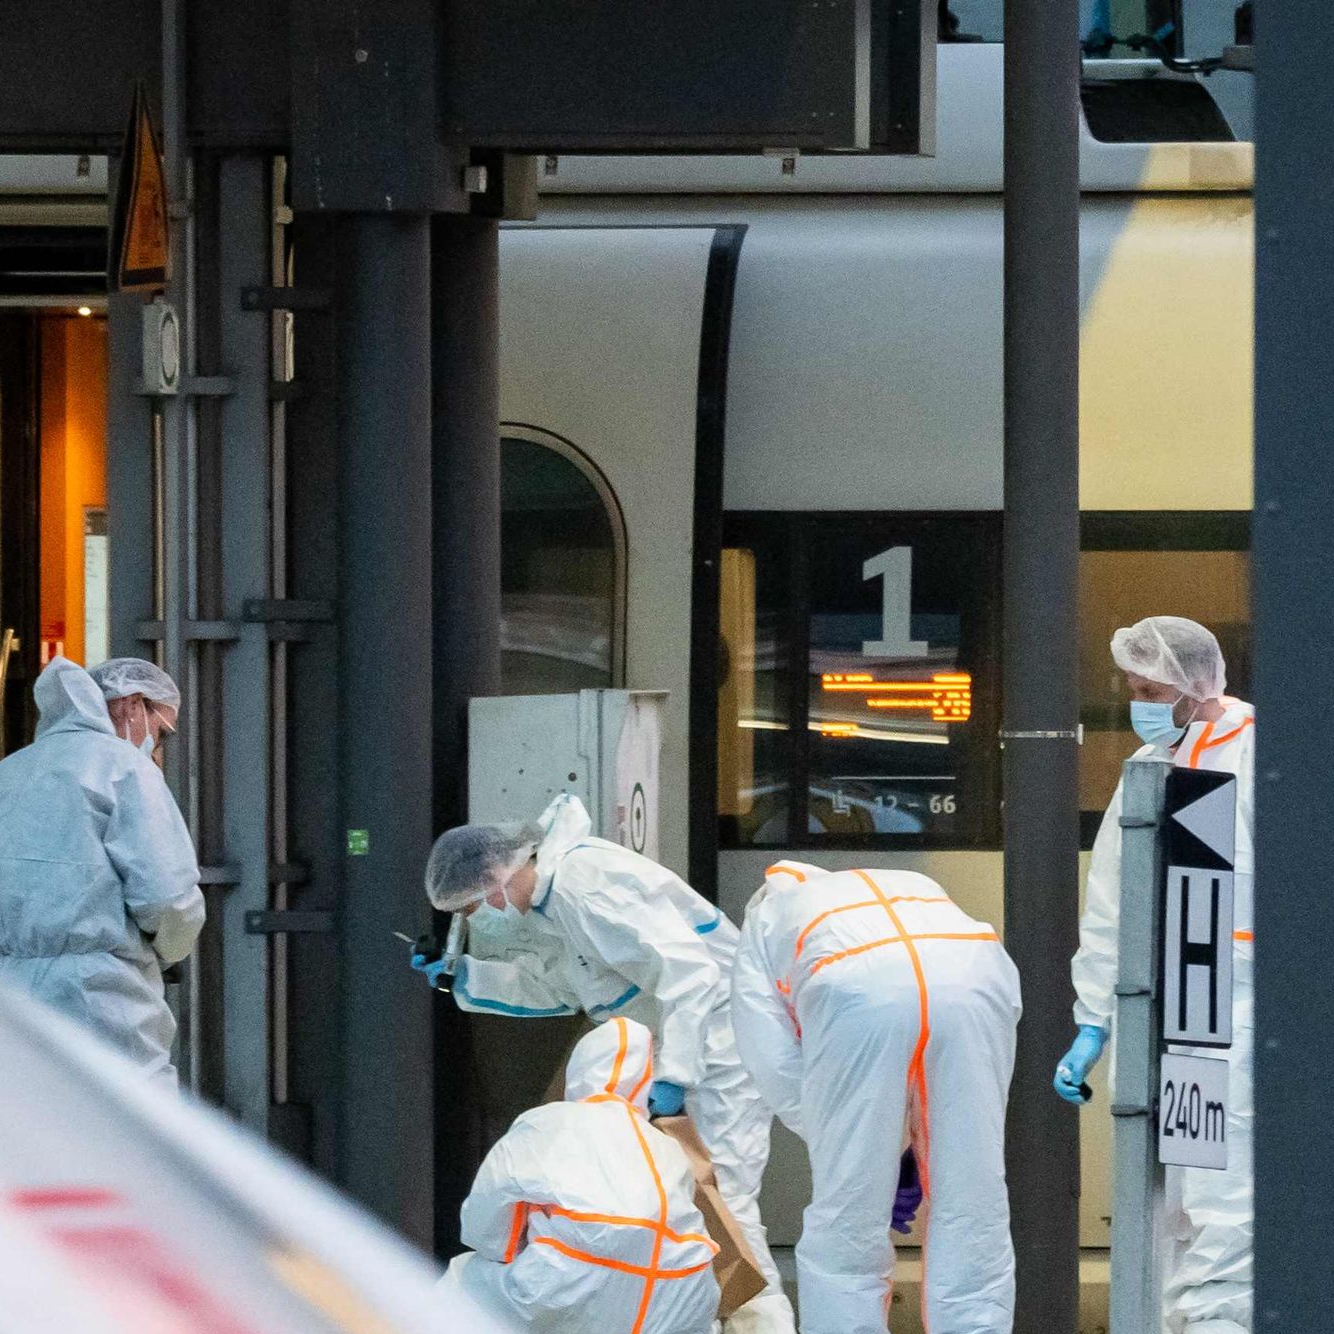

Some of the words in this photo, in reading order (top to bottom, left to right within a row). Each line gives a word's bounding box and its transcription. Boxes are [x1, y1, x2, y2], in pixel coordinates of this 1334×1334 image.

[862, 545, 929, 657] 1
[929, 794, 957, 814] 66
[1178, 874, 1220, 1034] H
